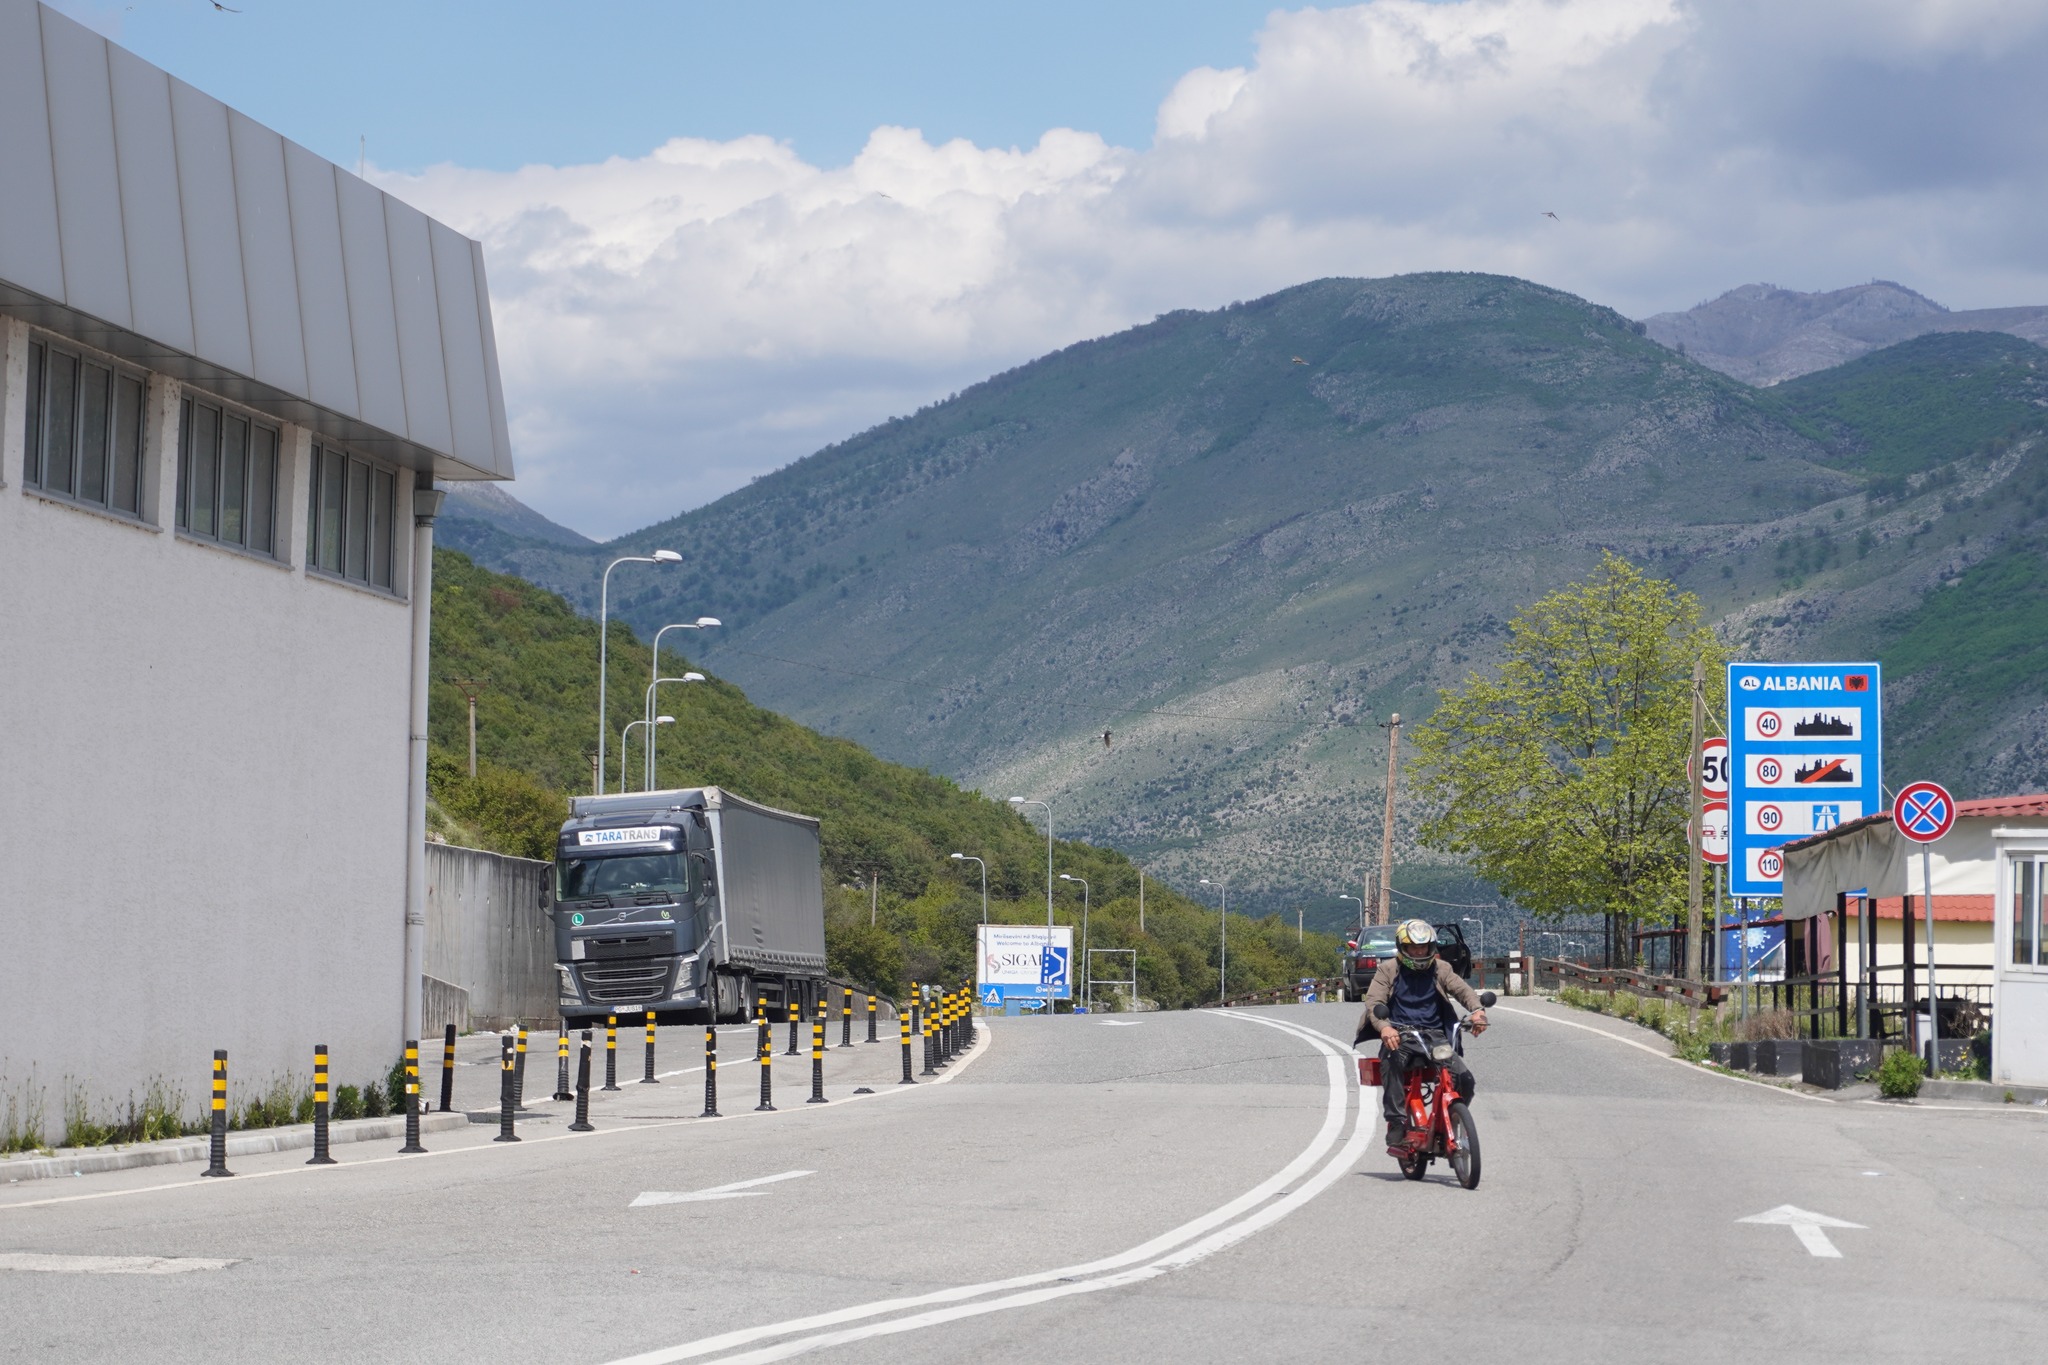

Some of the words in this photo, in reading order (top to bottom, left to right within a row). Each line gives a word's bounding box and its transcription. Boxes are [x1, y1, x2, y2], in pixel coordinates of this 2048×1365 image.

[1744, 679, 1757, 688] AL
[1763, 676, 1842, 691] ALBANIA
[1761, 718, 1776, 731] 40
[1762, 765, 1777, 777] 80
[1763, 812, 1777, 824] 90
[596, 829, 658, 842] TARATRANS
[1762, 860, 1778, 871] 110
